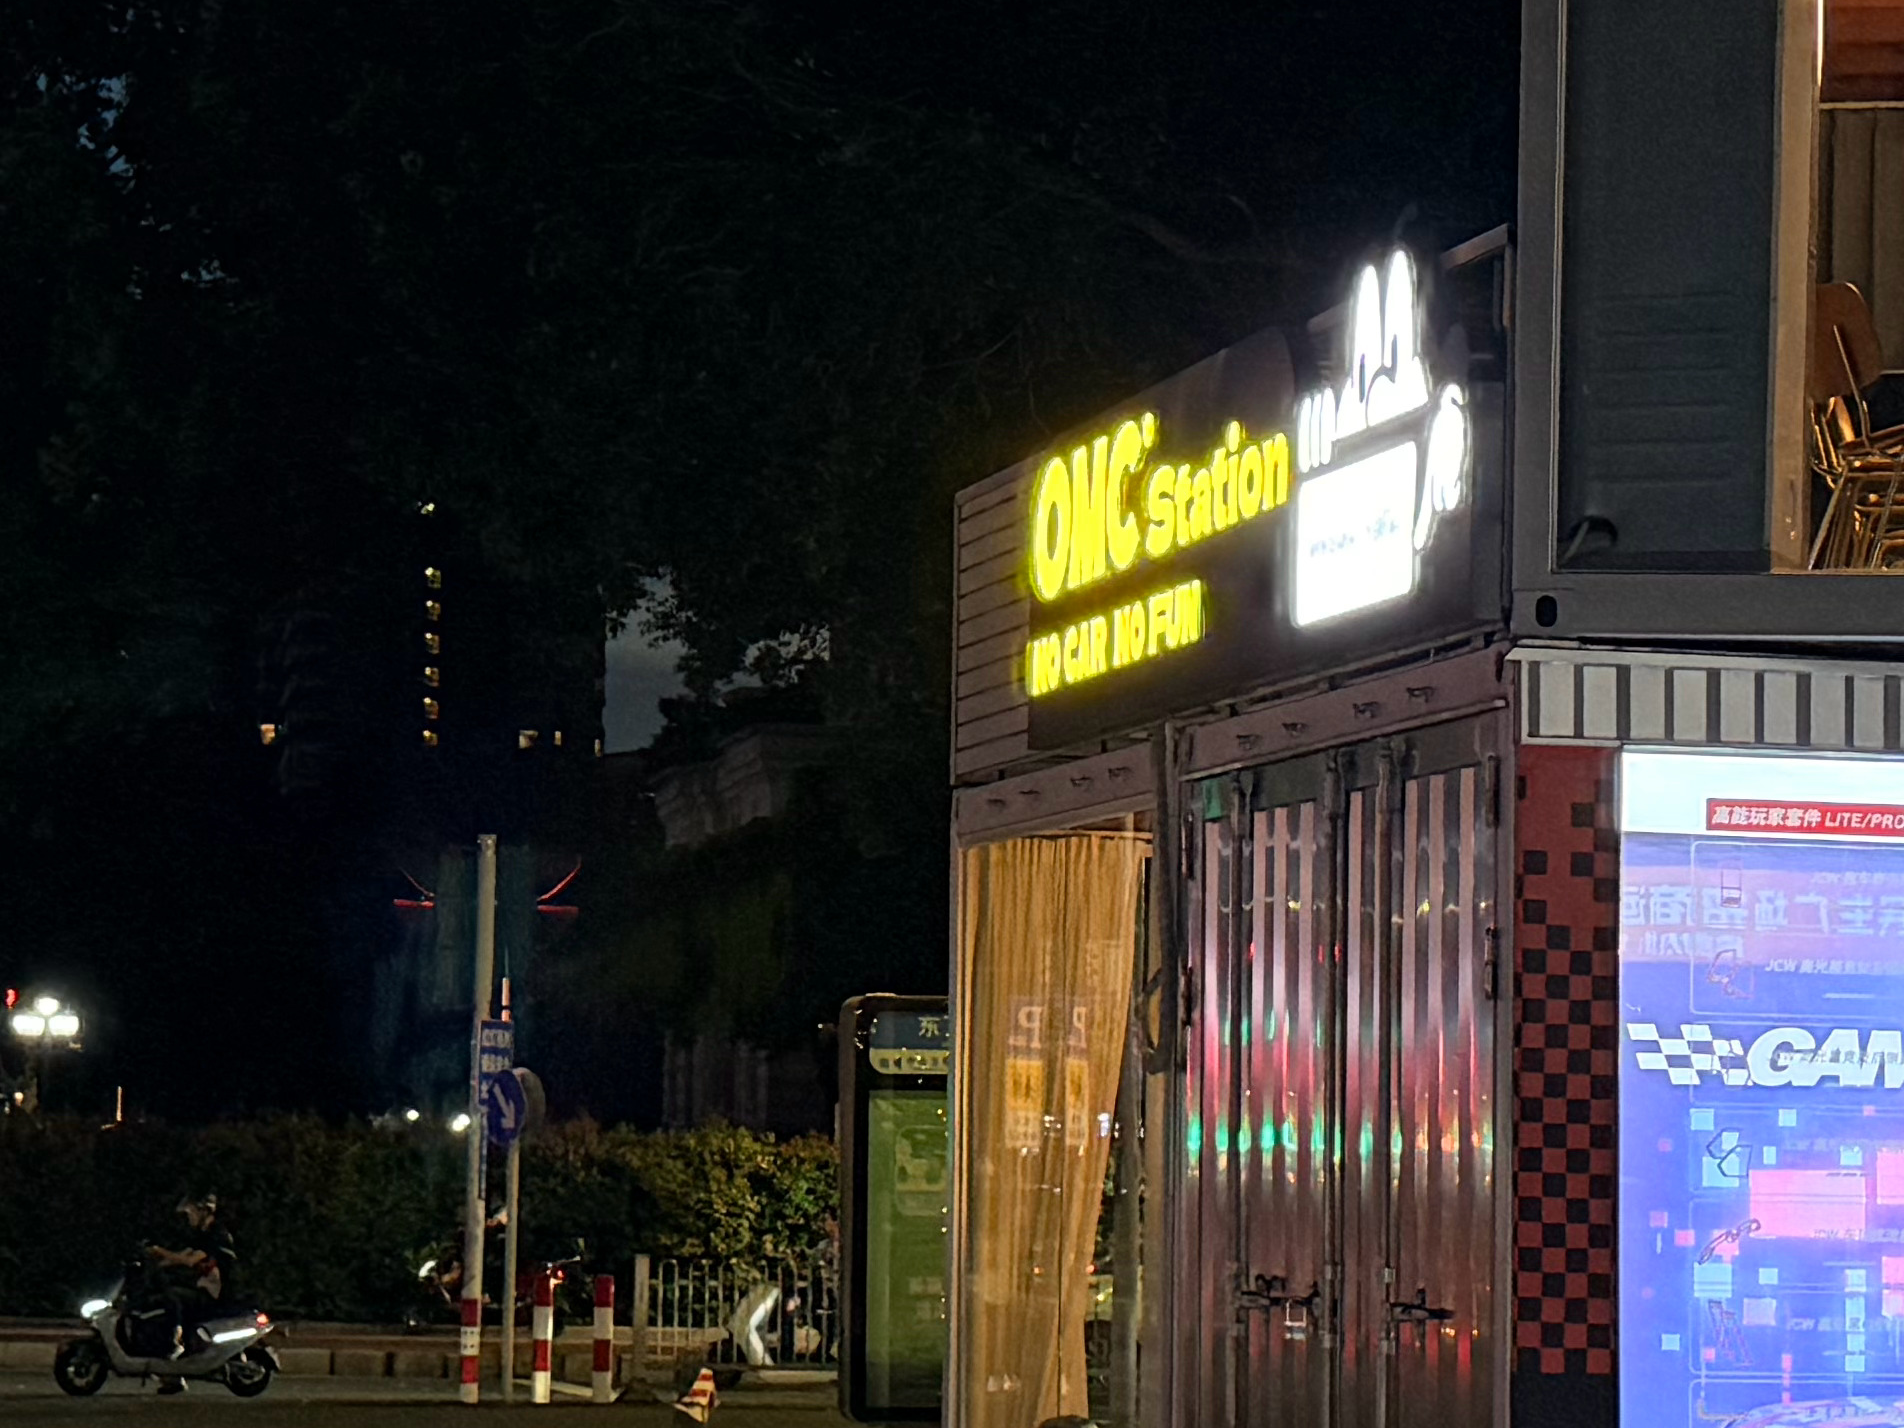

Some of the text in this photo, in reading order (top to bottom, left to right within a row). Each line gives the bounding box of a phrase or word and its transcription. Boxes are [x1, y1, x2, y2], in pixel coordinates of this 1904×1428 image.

[1144, 420, 1289, 557] Station
[1027, 578, 1206, 697] NO CAR NO FUN
[1711, 805, 1822, 828] 高能玩家套件
